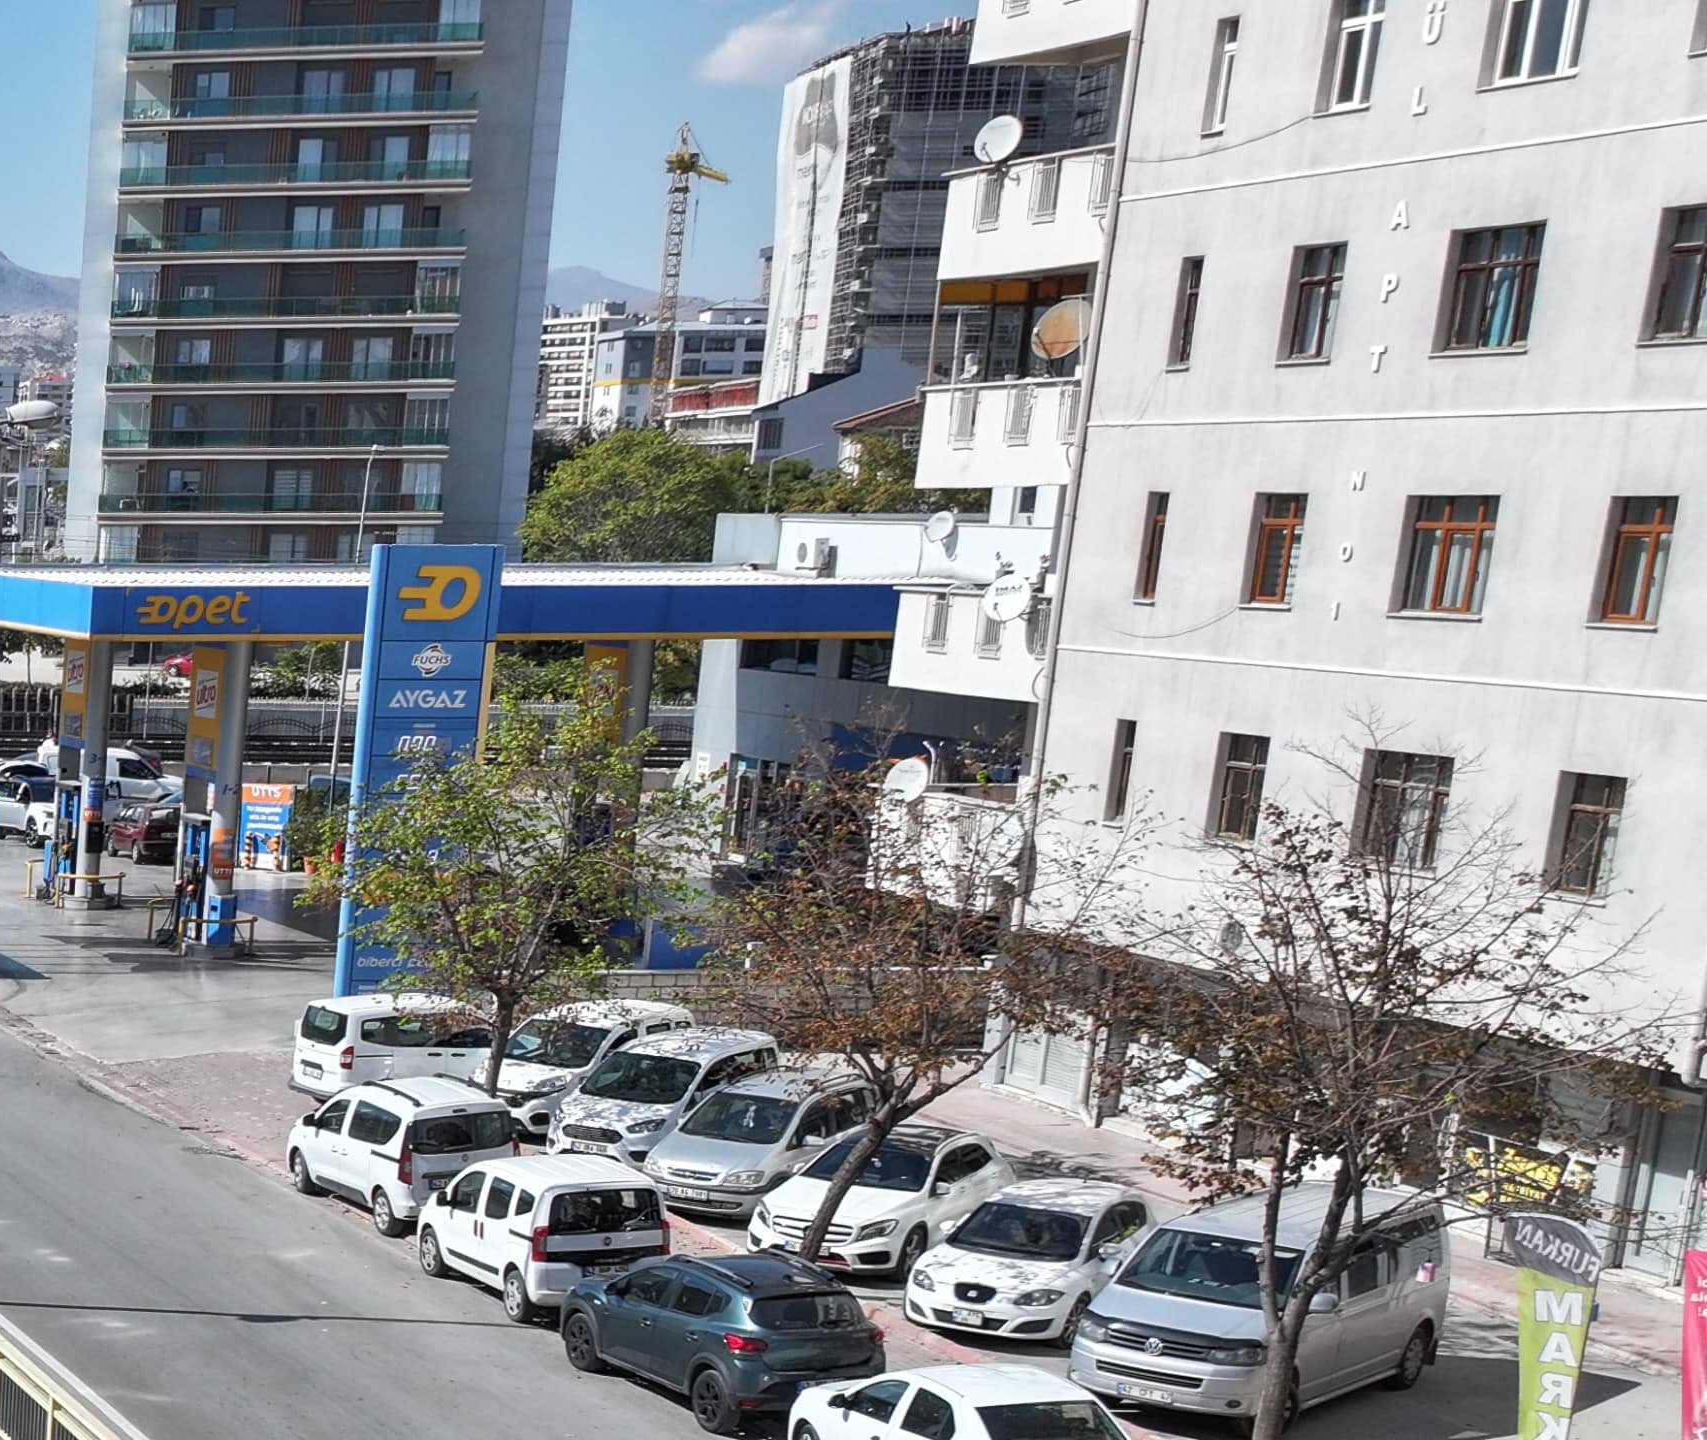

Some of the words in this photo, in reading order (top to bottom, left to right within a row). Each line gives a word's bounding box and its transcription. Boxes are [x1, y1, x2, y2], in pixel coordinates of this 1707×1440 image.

[414, 655, 450, 665] FUCHS
[390, 690, 467, 708] AYGAZ
[251, 786, 281, 798] UTTS
